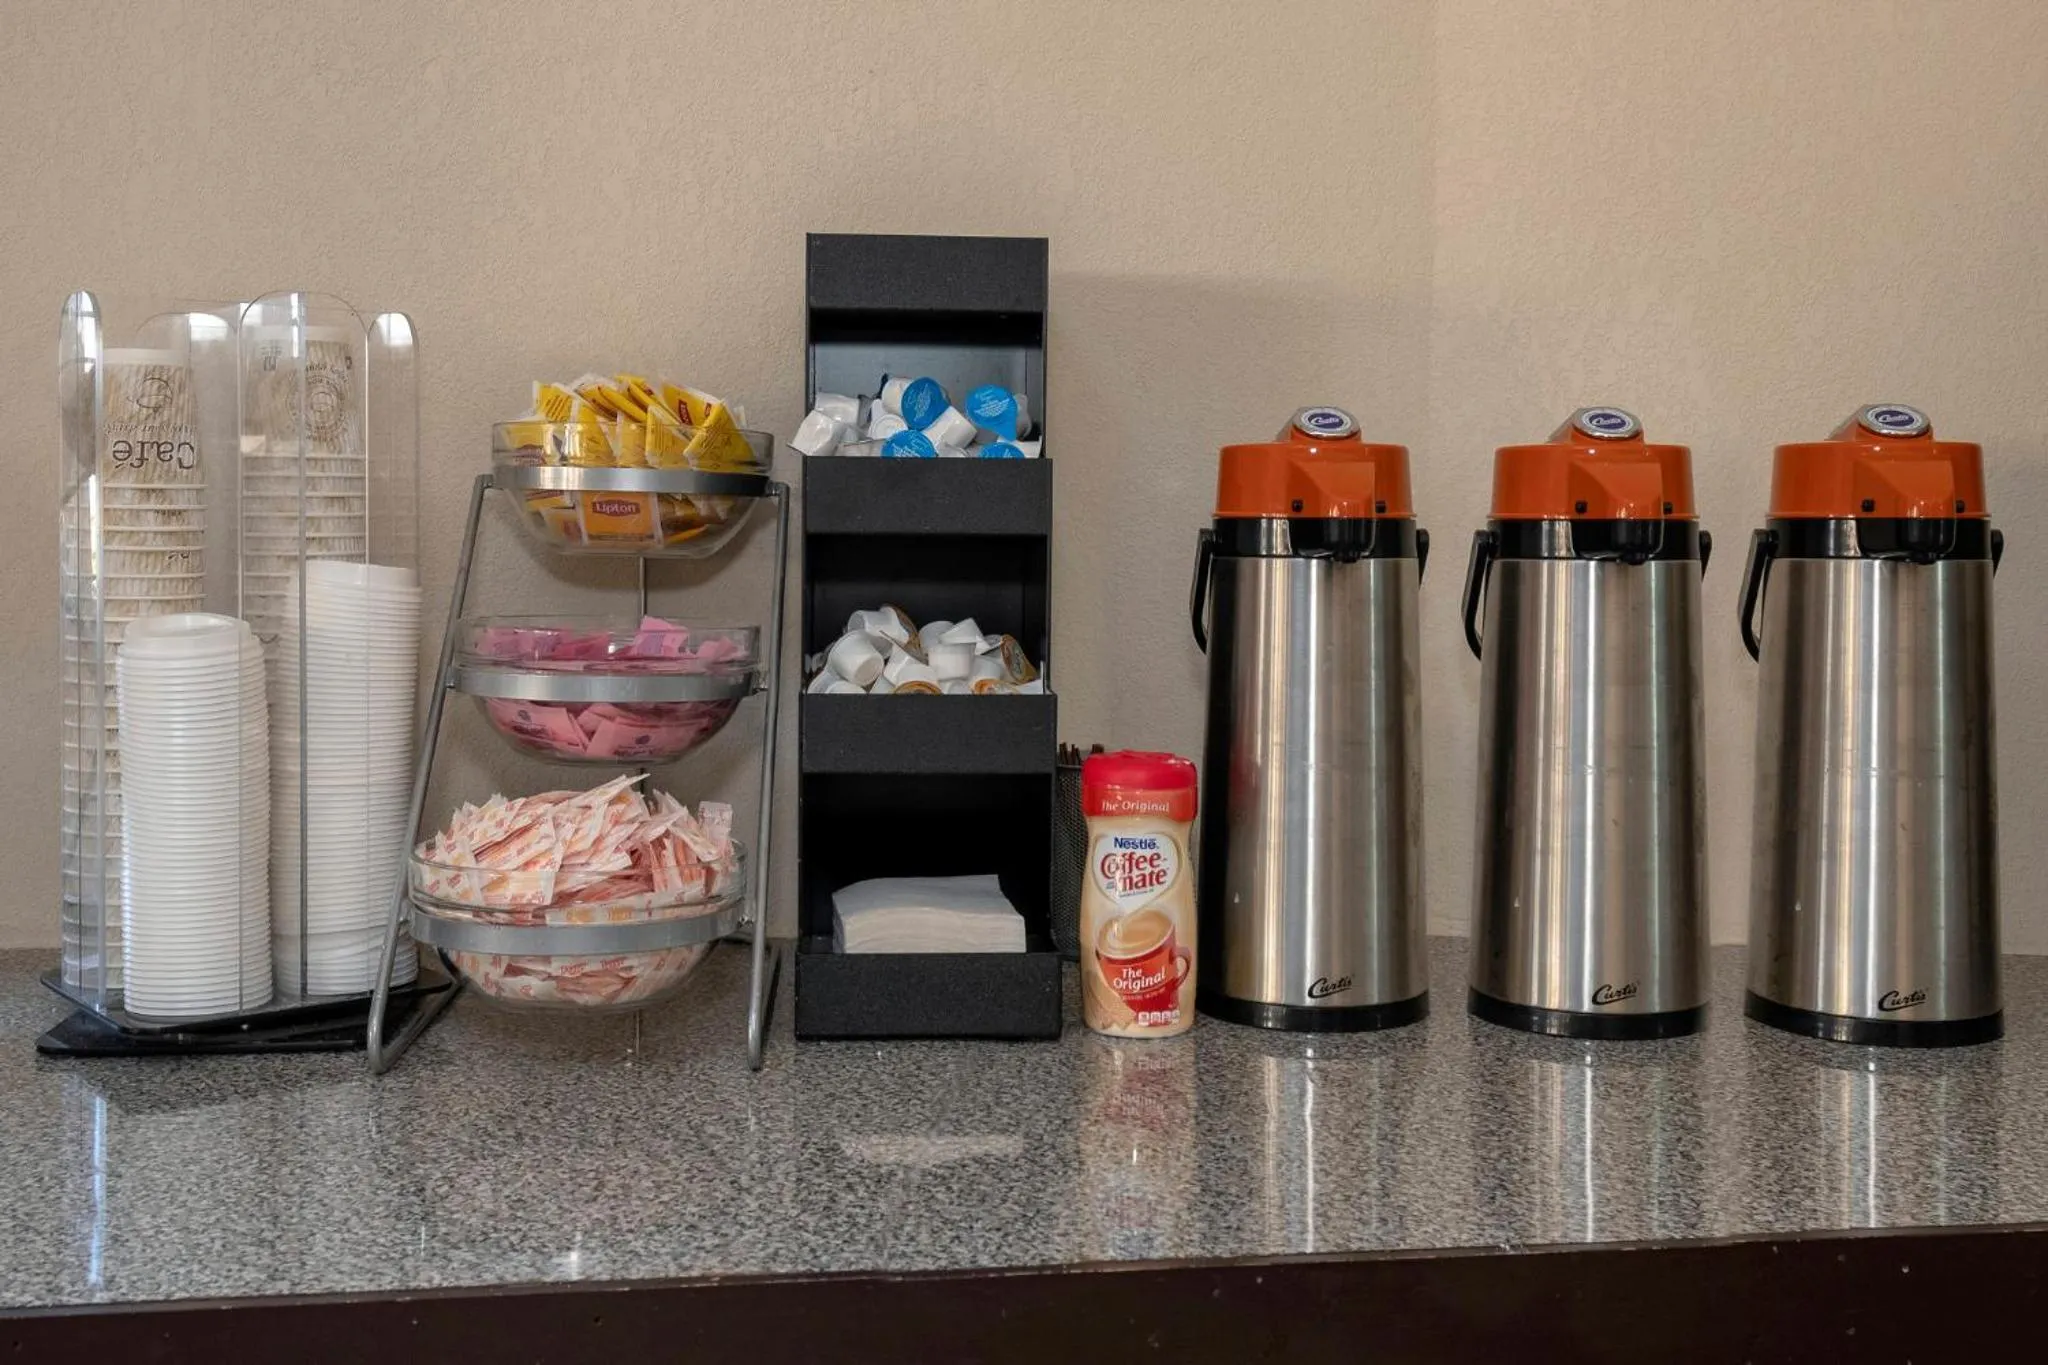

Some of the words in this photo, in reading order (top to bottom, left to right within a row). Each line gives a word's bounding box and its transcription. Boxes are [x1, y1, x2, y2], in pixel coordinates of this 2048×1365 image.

[112, 440, 195, 470] Café
[596, 502, 637, 515] Lipton
[1121, 801, 1170, 813] Original
[1113, 966, 1166, 993] Original
[1122, 968, 1143, 980] The
[1591, 983, 1638, 1006] Curtis
[1878, 989, 1927, 1012] Curtis
